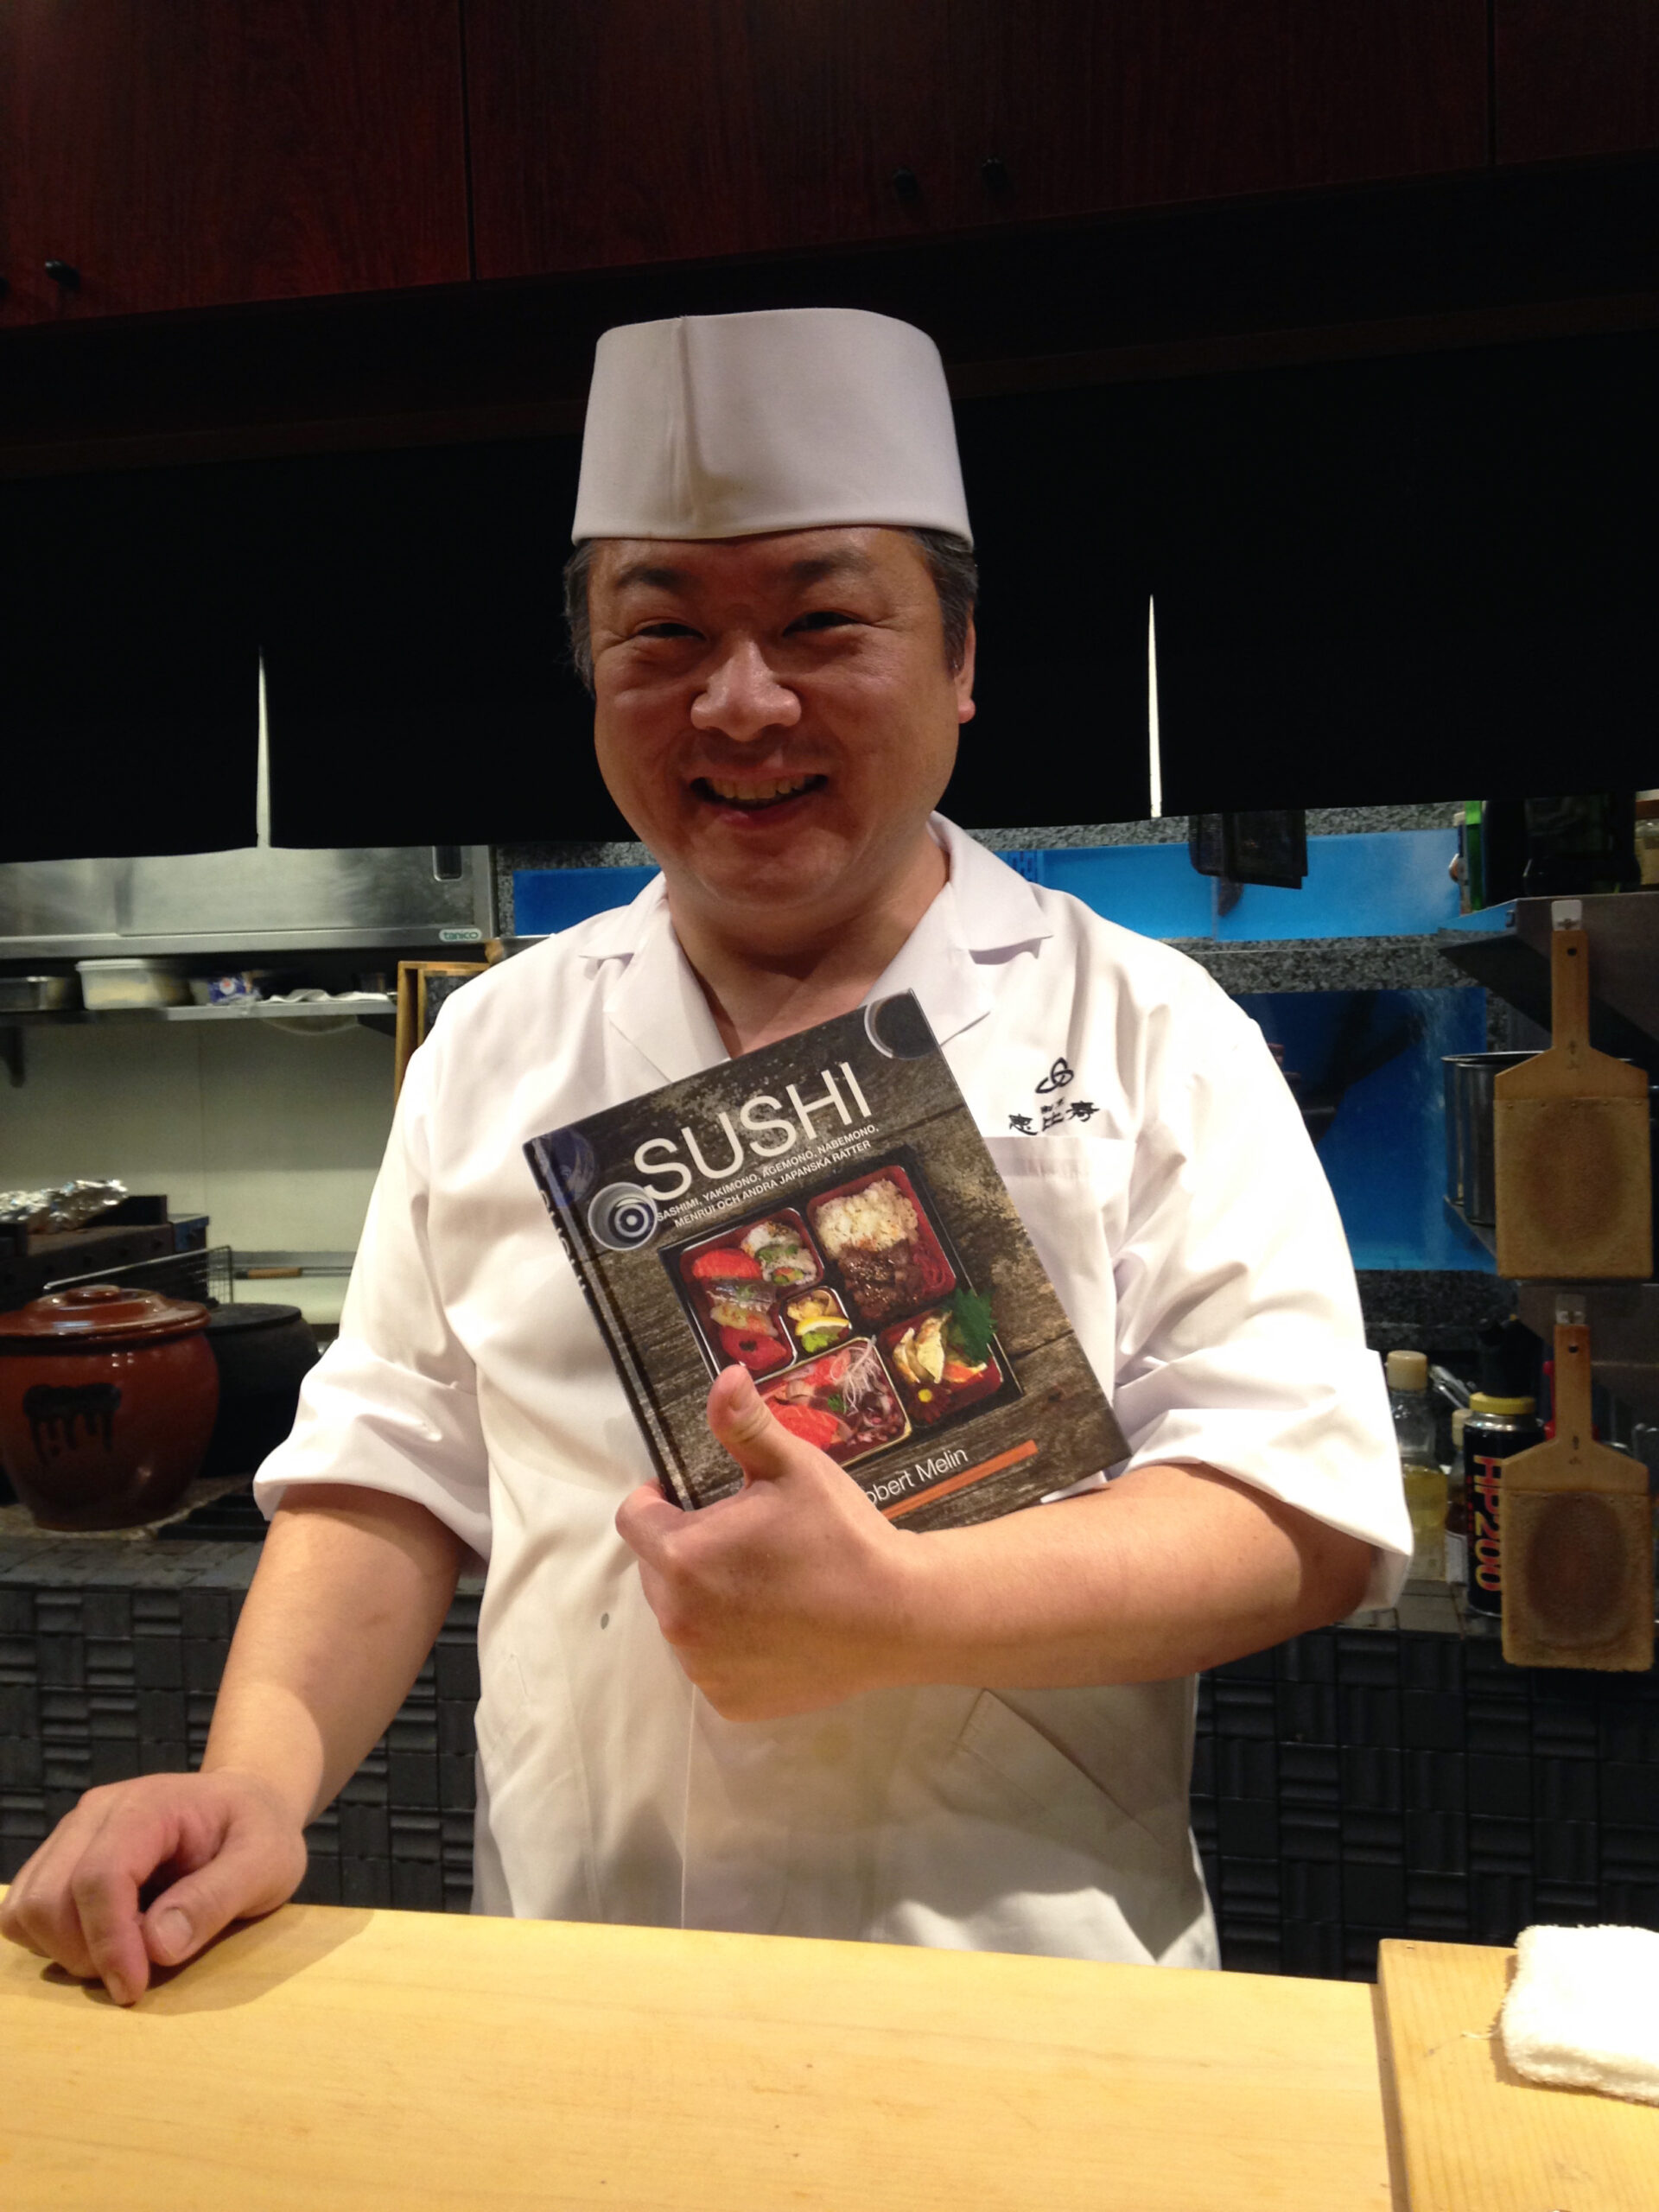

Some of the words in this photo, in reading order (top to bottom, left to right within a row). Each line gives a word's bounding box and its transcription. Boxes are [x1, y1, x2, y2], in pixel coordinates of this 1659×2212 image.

[634, 1062, 872, 1201] SUSHI
[657, 1197, 702, 1222] SASHIMI,
[702, 1173, 761, 1202] YAKIMONO,
[762, 1150, 817, 1178] AGEMONO,
[817, 1124, 879, 1154] NABEMONO,
[674, 1205, 715, 1228] MENRUI
[716, 1194, 741, 1210] OCH
[742, 1179, 778, 1200] ANDRA
[779, 1157, 831, 1185] JAPANSKA
[865, 1470, 915, 1504] obert
[915, 1449, 969, 1482] Melin
